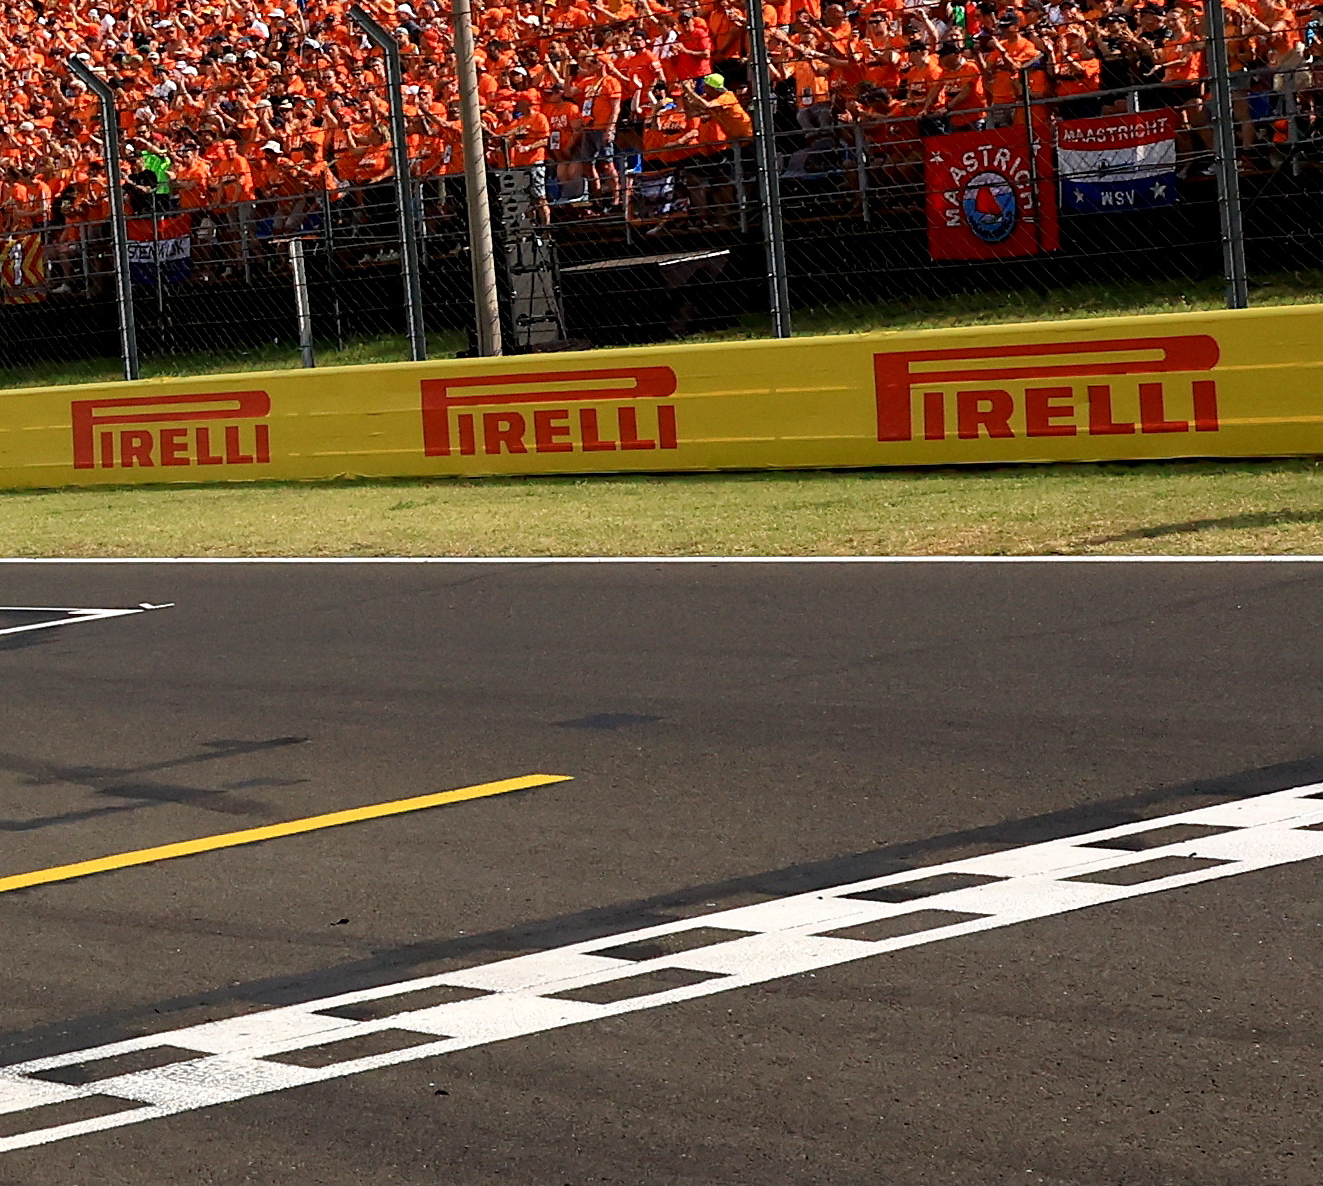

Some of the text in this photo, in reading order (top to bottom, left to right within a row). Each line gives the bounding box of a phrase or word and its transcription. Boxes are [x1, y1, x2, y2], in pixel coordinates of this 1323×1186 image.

[1063, 117, 1169, 143] MAASTRICHT
[71, 390, 272, 470] PIRELLI
[420, 365, 678, 457] PIRELLI
[873, 334, 1220, 443] PIRELLI
